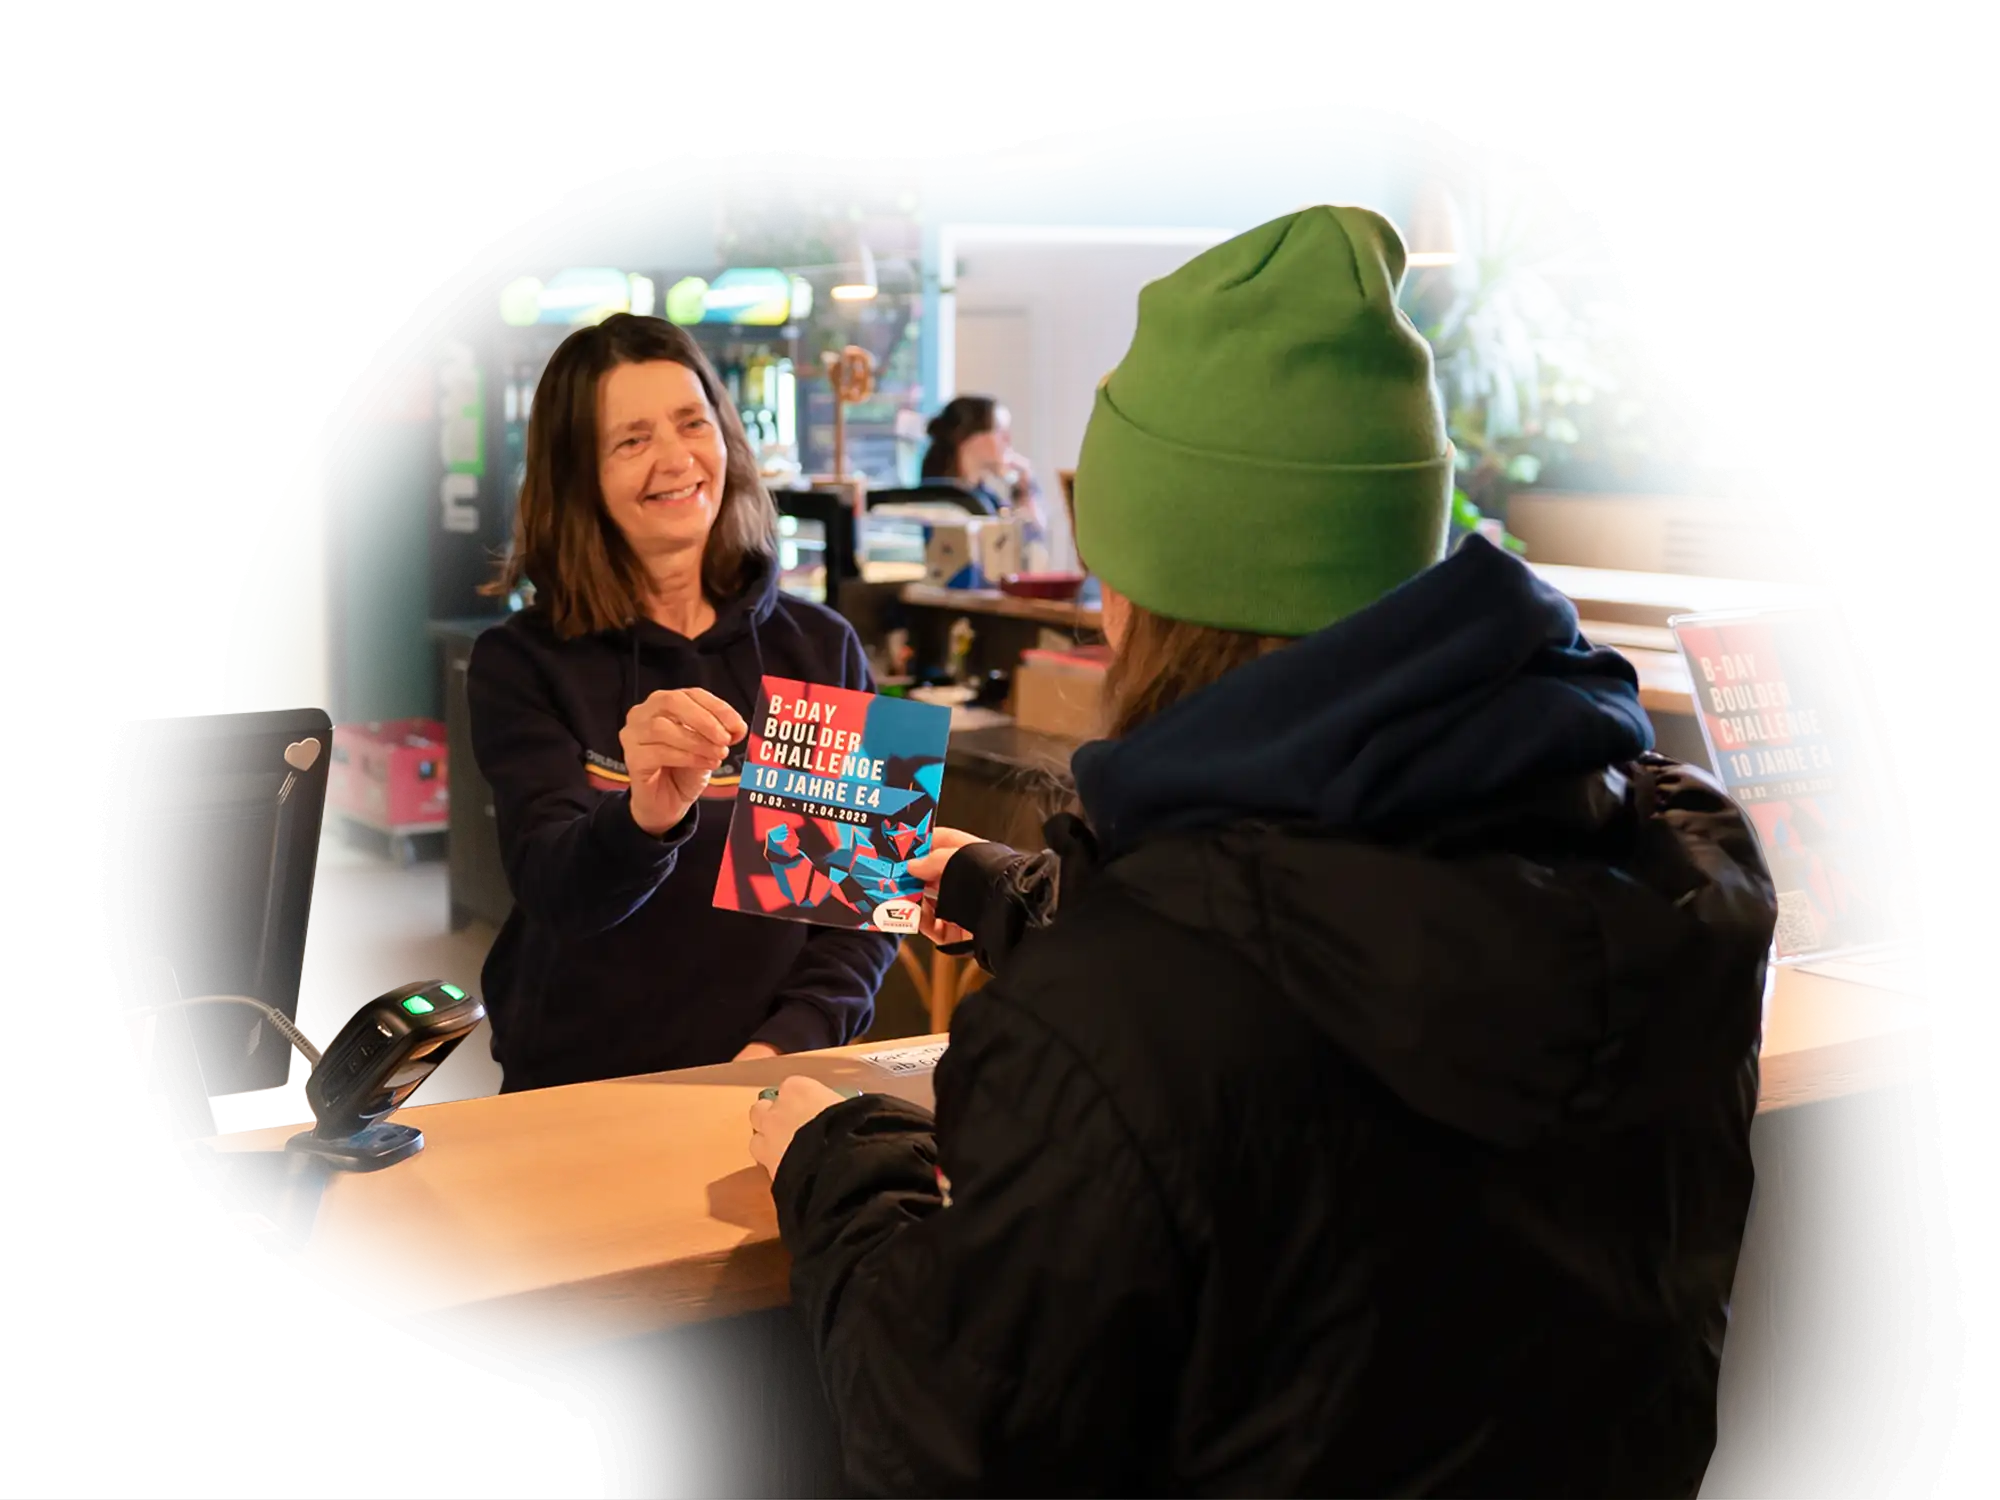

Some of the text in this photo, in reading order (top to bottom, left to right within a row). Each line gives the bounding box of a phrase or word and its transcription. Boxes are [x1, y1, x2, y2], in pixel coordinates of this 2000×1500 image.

[1700, 653, 1758, 682] B-DAY
[769, 695, 837, 724] B-DAY
[1709, 681, 1792, 713] BOULDER
[764, 717, 861, 752] BOULDER
[1720, 709, 1822, 744] CHALLENGE
[760, 741, 884, 780] CHALLENGE
[1730, 745, 1833, 778] 10 JAHRE E4
[755, 768, 778, 789] 10
[784, 774, 848, 802] JAHRE
[855, 785, 881, 808] E4
[802, 802, 867, 824] 12.04.2023
